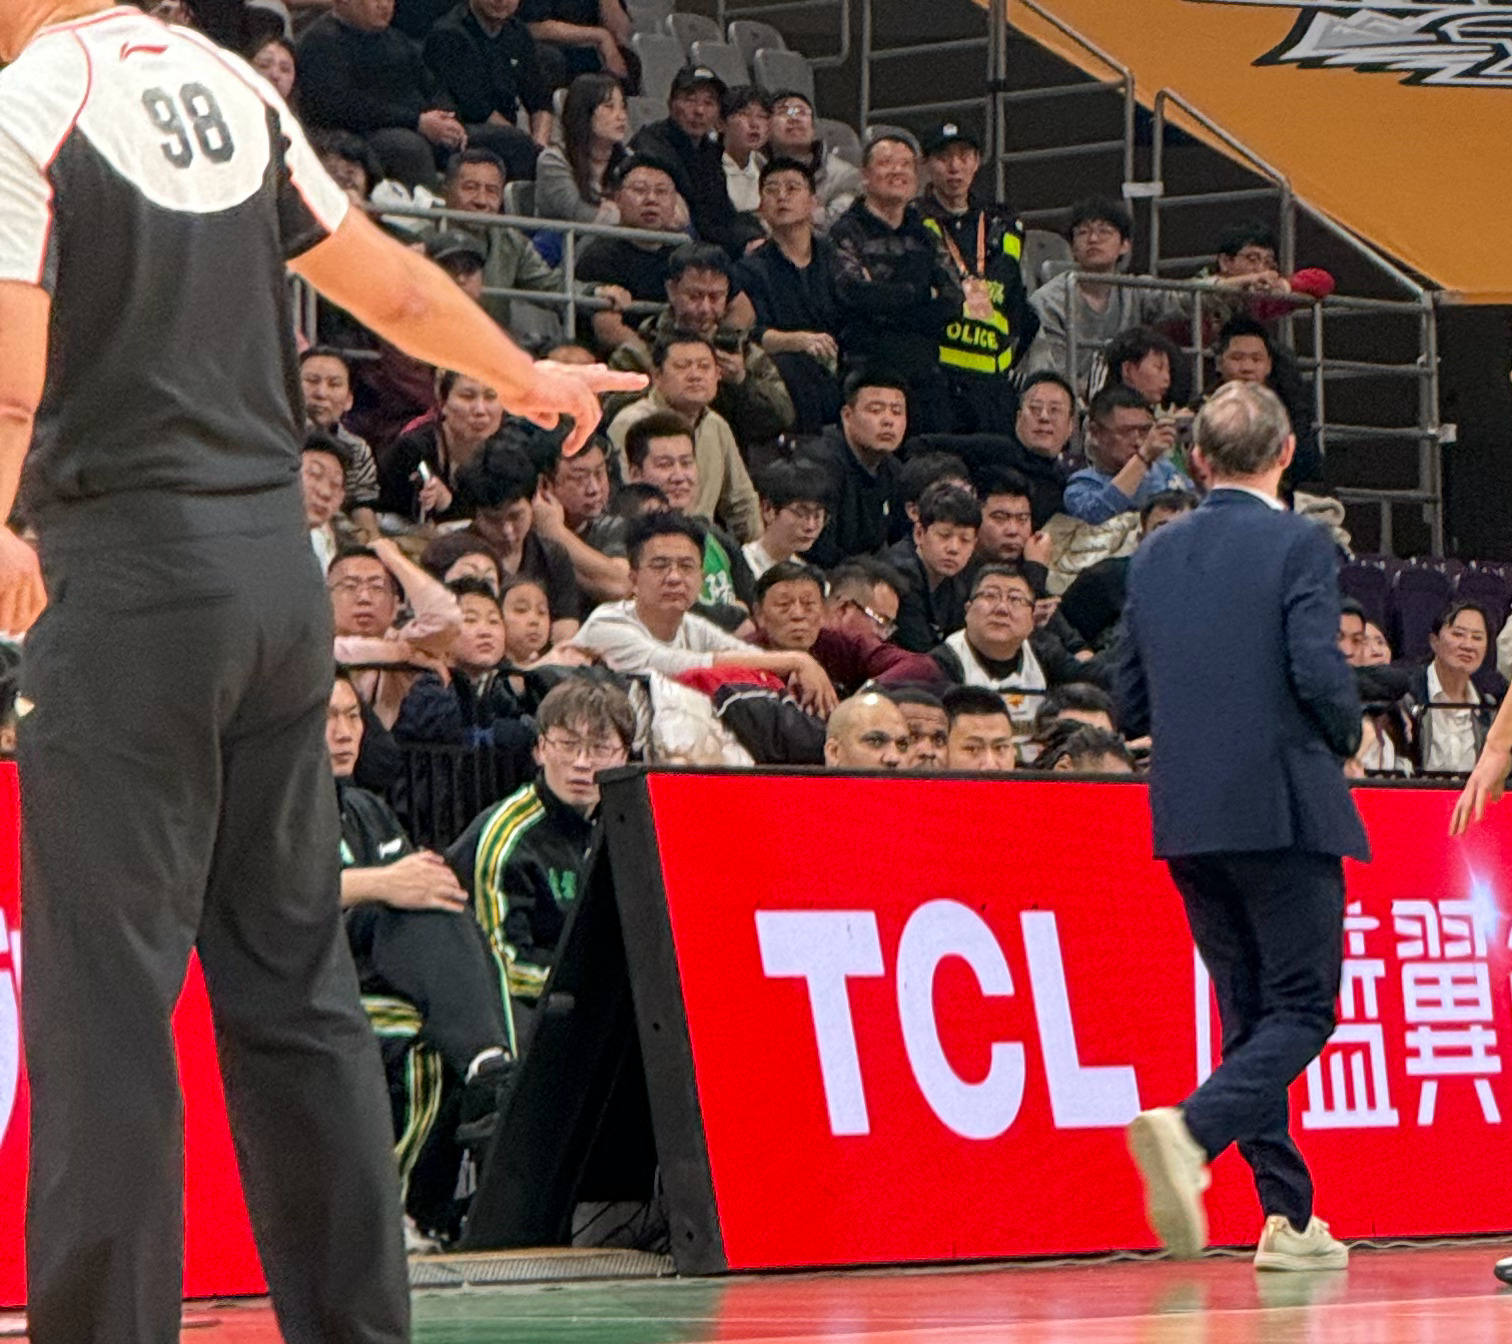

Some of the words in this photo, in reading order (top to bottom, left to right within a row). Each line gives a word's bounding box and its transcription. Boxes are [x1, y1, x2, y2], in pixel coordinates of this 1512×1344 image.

[143, 80, 236, 170] 98
[945, 321, 998, 350] OLICE
[753, 897, 1142, 1140] TCL
